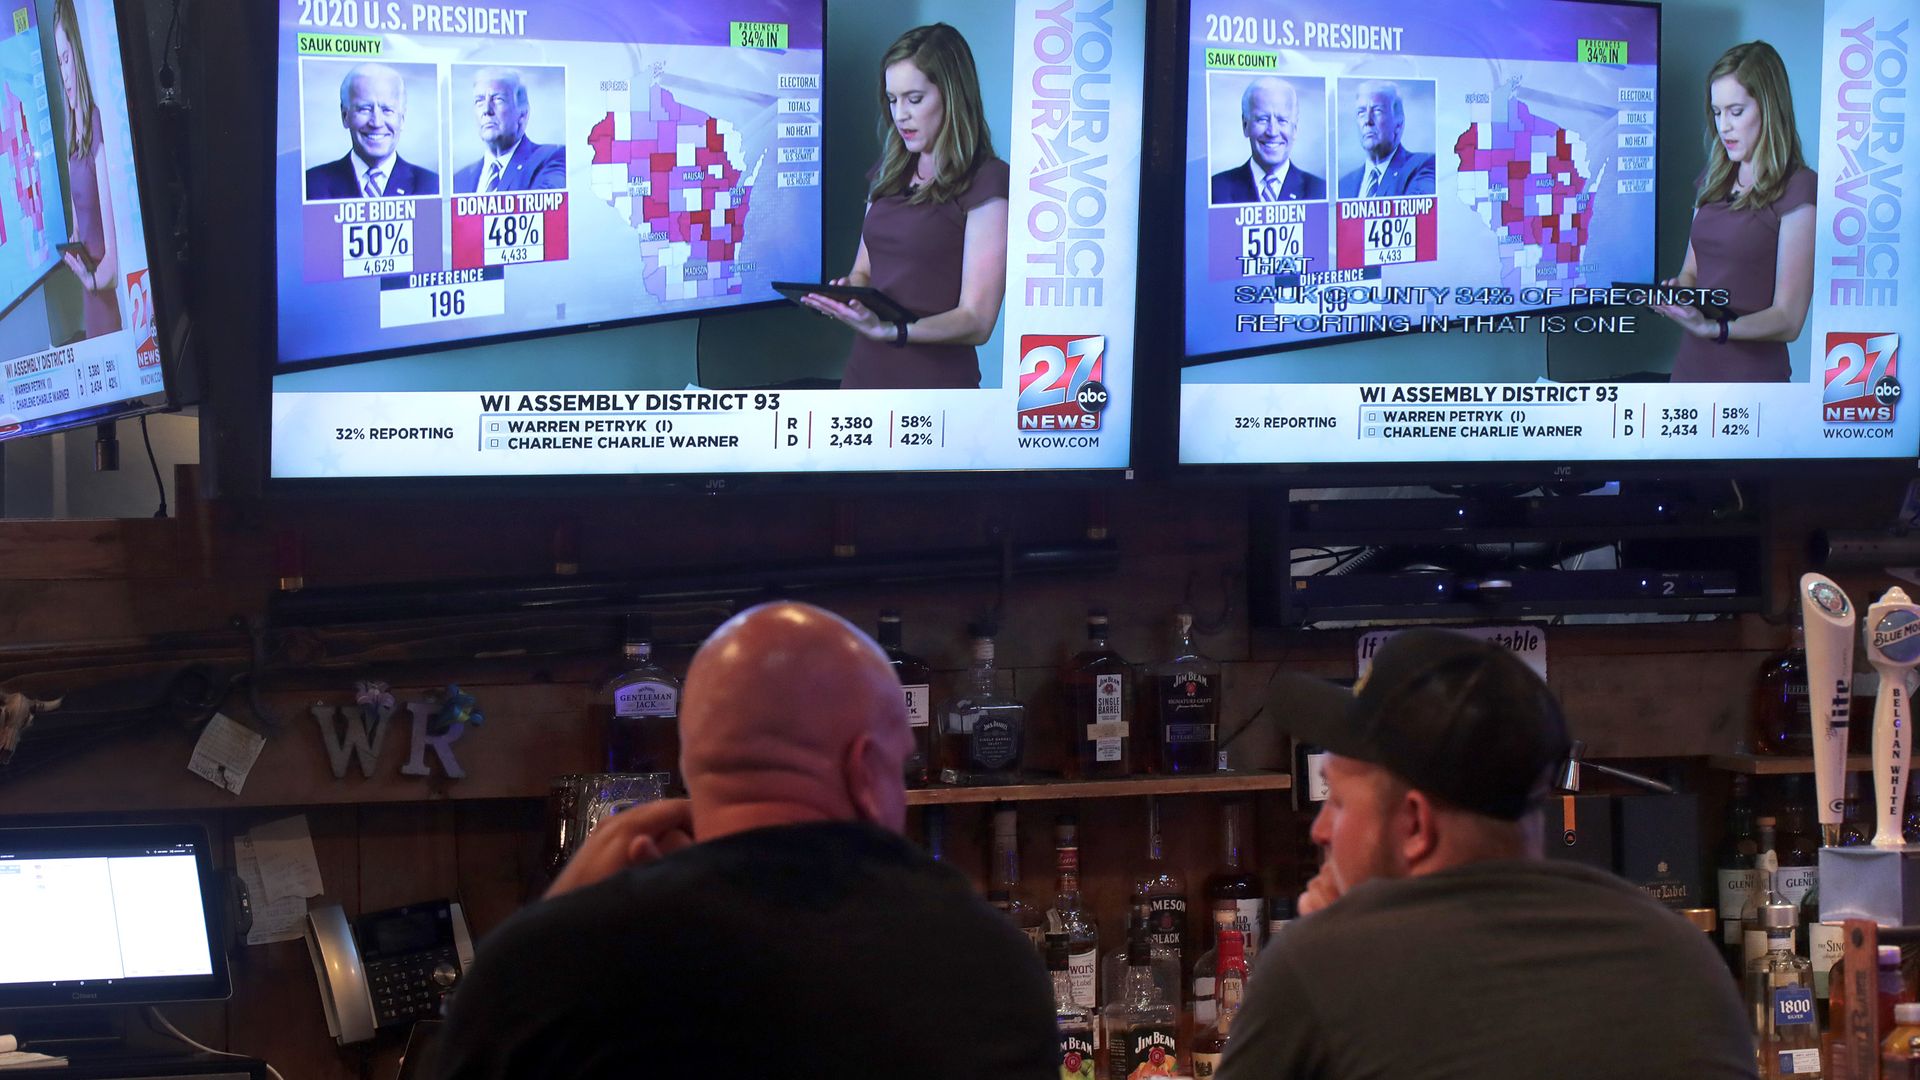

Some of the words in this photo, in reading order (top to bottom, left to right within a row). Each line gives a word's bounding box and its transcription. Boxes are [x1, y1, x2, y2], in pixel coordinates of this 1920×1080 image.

[299, 0, 358, 28] 2020
[364, 1, 407, 31] U.S.
[412, 4, 528, 35] PRESIDENT
[739, 23, 780, 32] PRECINCTS
[1206, 14, 1258, 44] 2020
[1263, 18, 1300, 46] U.S.
[1304, 22, 1404, 51] PRESIDENT
[300, 37, 332, 52] SAUK
[335, 39, 381, 54] COUNTY
[741, 31, 764, 47] 34%
[767, 32, 778, 48] IN
[1208, 52, 1235, 66] SAUK
[1238, 53, 1277, 68] COUNTY
[1587, 48, 1607, 63] 34%
[1609, 49, 1618, 64] IN
[1032, 0, 1074, 130] YOUR
[1072, 0, 1114, 143] YOUR
[780, 76, 817, 88] ELECTORAL
[1837, 17, 1874, 141] YOUR
[1872, 18, 1909, 153] YOUR
[1621, 90, 1652, 101] ELECTORAL
[788, 101, 811, 112] TOTALS
[1627, 113, 1646, 123] TOTALS
[786, 126, 795, 136] NO
[796, 126, 812, 136] HEAT
[1625, 136, 1633, 146] NO
[1634, 136, 1647, 146] HEAT
[334, 203, 366, 223] JOE
[369, 200, 416, 221] BIDEN
[457, 196, 515, 216] DONALD
[517, 193, 563, 213] TRUMP
[1342, 201, 1392, 219] DONALD
[1394, 198, 1433, 216] TRUMP
[1235, 208, 1263, 226] JOE
[1266, 205, 1306, 223] BIDEN
[488, 215, 539, 246] 48%
[1025, 166, 1068, 306] VOTE
[1065, 154, 1108, 306] VOICE
[1368, 219, 1412, 248] 48%
[1865, 164, 1903, 306] VOICE
[348, 223, 408, 258] 50%
[1248, 225, 1299, 258] 50%
[1830, 175, 1868, 306] VOTE
[501, 249, 528, 263] 4,433
[1379, 250, 1402, 263] 4,433
[363, 260, 395, 275] 4,629
[684, 267, 708, 276] MADISON
[1237, 257, 1314, 275] THAT
[409, 269, 484, 288] DIFFERENCE
[1300, 269, 1364, 286] DIFFERENCE
[430, 289, 465, 318] 196
[1234, 285, 1319, 304] SAUK
[1322, 285, 1450, 304] COUNTY
[1455, 286, 1513, 305] 34%
[1521, 287, 1562, 305] OF
[1570, 288, 1729, 306] PRECINCTS
[1236, 314, 1409, 333] REPORTING
[1422, 314, 1448, 333] IN
[1455, 315, 1531, 333] THAT
[1540, 315, 1566, 333] IS
[1574, 315, 1636, 333] ONE
[14, 356, 41, 378] ASSEMBLY
[42, 350, 66, 370] DISTRICT
[66, 348, 74, 364] 93
[138, 349, 160, 366] NEWS
[1017, 336, 1105, 412] 27
[1823, 333, 1899, 405] 27
[1078, 388, 1107, 403] abc
[1360, 387, 1385, 402] WI
[1392, 387, 1497, 402] ASSEMBLY
[1502, 386, 1590, 402] DISTRICT
[1596, 386, 1618, 402] 93
[1875, 383, 1900, 396] abc
[480, 395, 510, 412] WI
[518, 394, 639, 411] ASSEMBLY
[646, 394, 748, 410] DISTRICT
[754, 393, 780, 410] 93
[1022, 414, 1096, 429] NEWS
[1384, 411, 1446, 422] WARREN
[1450, 411, 1503, 422] PETRYK
[1510, 410, 1526, 423] (I)
[1624, 409, 1633, 420] R
[1662, 408, 1698, 422] 3,380
[1722, 408, 1749, 419] 58%
[1826, 407, 1891, 420] NEWS
[508, 420, 580, 433] WARREN
[585, 420, 647, 433] PETRYK
[655, 420, 673, 433] (I)
[787, 418, 798, 430] R
[830, 416, 873, 430] 3,380
[901, 416, 932, 428] 58%
[1235, 417, 1260, 428] 32%
[1264, 416, 1336, 428] REPORTING
[1721, 424, 1750, 436] 42%
[336, 428, 365, 440] 32%
[370, 427, 454, 440] REPORTING
[1384, 426, 1456, 438] CHARLENE
[1460, 426, 1518, 438] CHARLIE
[1523, 426, 1582, 437] WARNER
[1624, 425, 1634, 436] D
[1661, 424, 1698, 438] 2,434
[1823, 428, 1894, 438] WKOW.COM
[508, 437, 592, 449] CHARLENE
[597, 436, 665, 448] CHARLIE
[670, 436, 738, 448] WARNER
[787, 434, 798, 446] D
[830, 434, 873, 448] 2,434
[900, 433, 933, 446] 42%
[1018, 437, 1099, 448] WKOW.COM
[1873, 629, 1904, 647] BLUE
[1362, 637, 1377, 658] If
[1173, 673, 1187, 688] JIM
[1188, 672, 1207, 686] BEAM
[620, 693, 672, 702] GENTLEMAN
[636, 701, 656, 709] JACK
[1098, 697, 1120, 706] SINGLE
[1098, 706, 1120, 715] BARREL
[1892, 688, 1902, 758] BELGIAN
[1890, 766, 1901, 816] WHITE
[1780, 999, 1810, 1014] 1800
[1068, 1036, 1092, 1056] BEAM
[1135, 1036, 1153, 1054] JIM
[1153, 1031, 1176, 1050] BEAM
